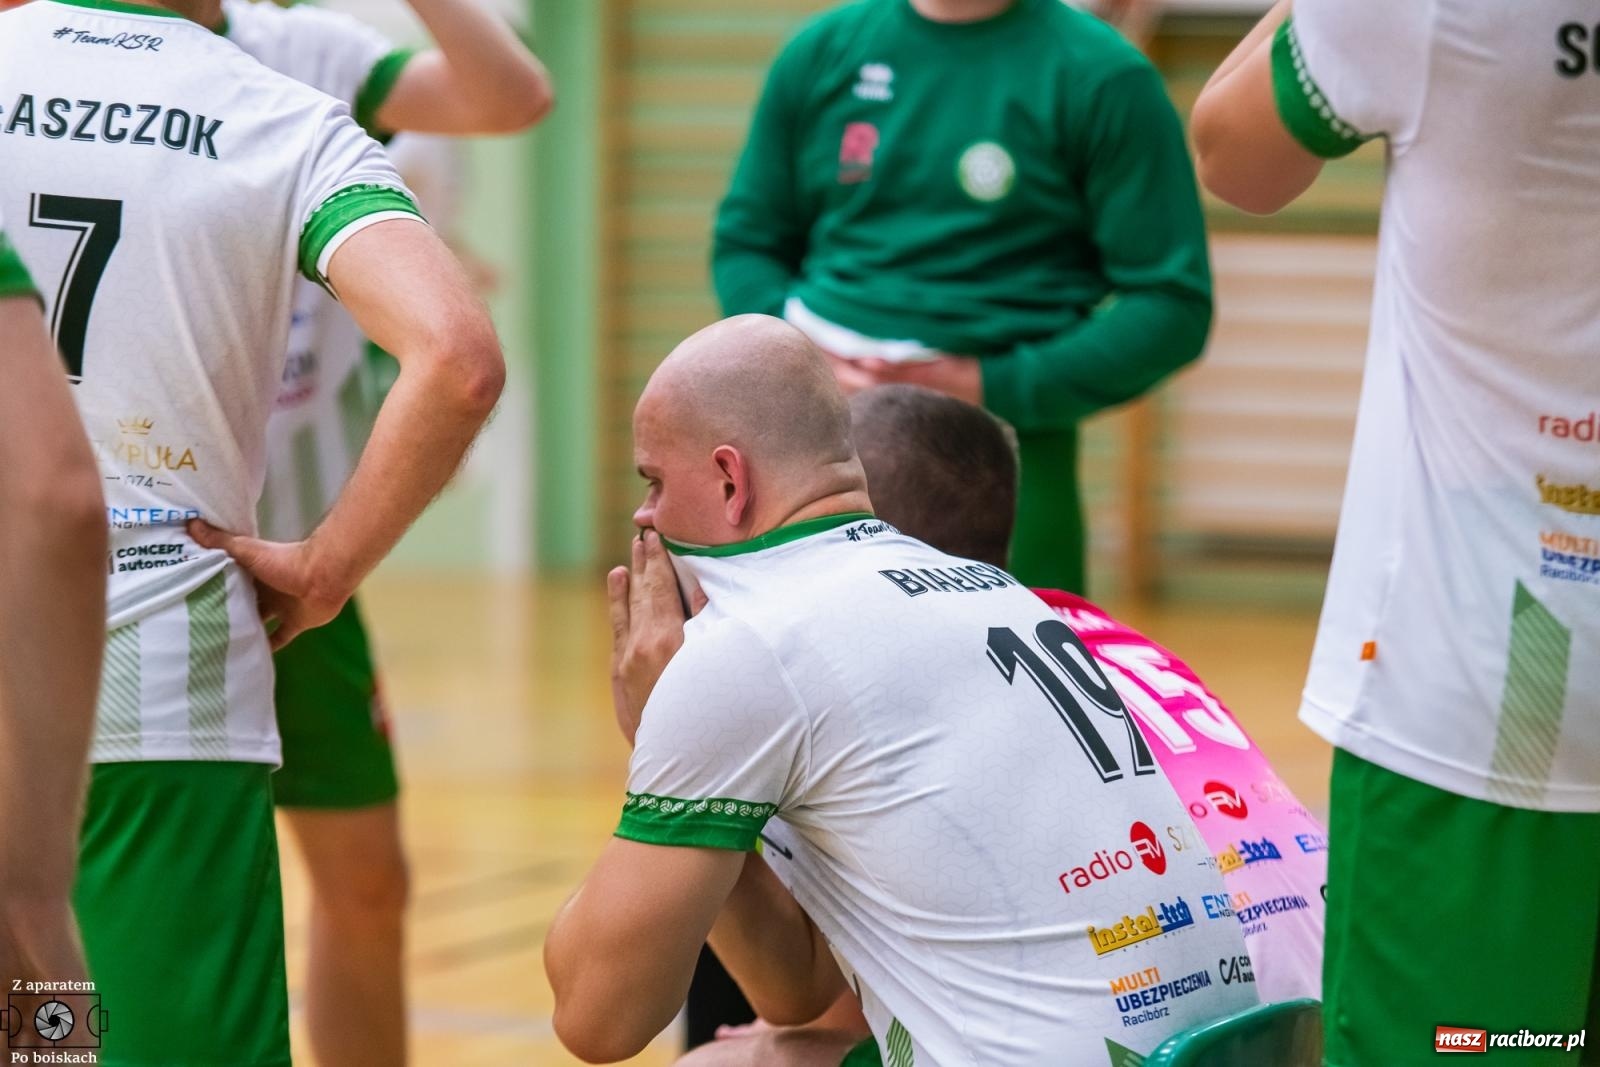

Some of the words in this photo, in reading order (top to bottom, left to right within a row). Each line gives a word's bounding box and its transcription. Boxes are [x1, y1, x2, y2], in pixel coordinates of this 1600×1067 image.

[0, 93, 224, 160] ASZCZOK
[29, 192, 123, 385] 7
[116, 543, 184, 558] CONCEPT
[986, 619, 1156, 783] 19
[1059, 850, 1133, 893] radio
[1110, 967, 1161, 994] MULTI
[1115, 970, 1212, 1013] UBEZPIECZENIA
[1122, 1007, 1170, 1027] Racibórz
